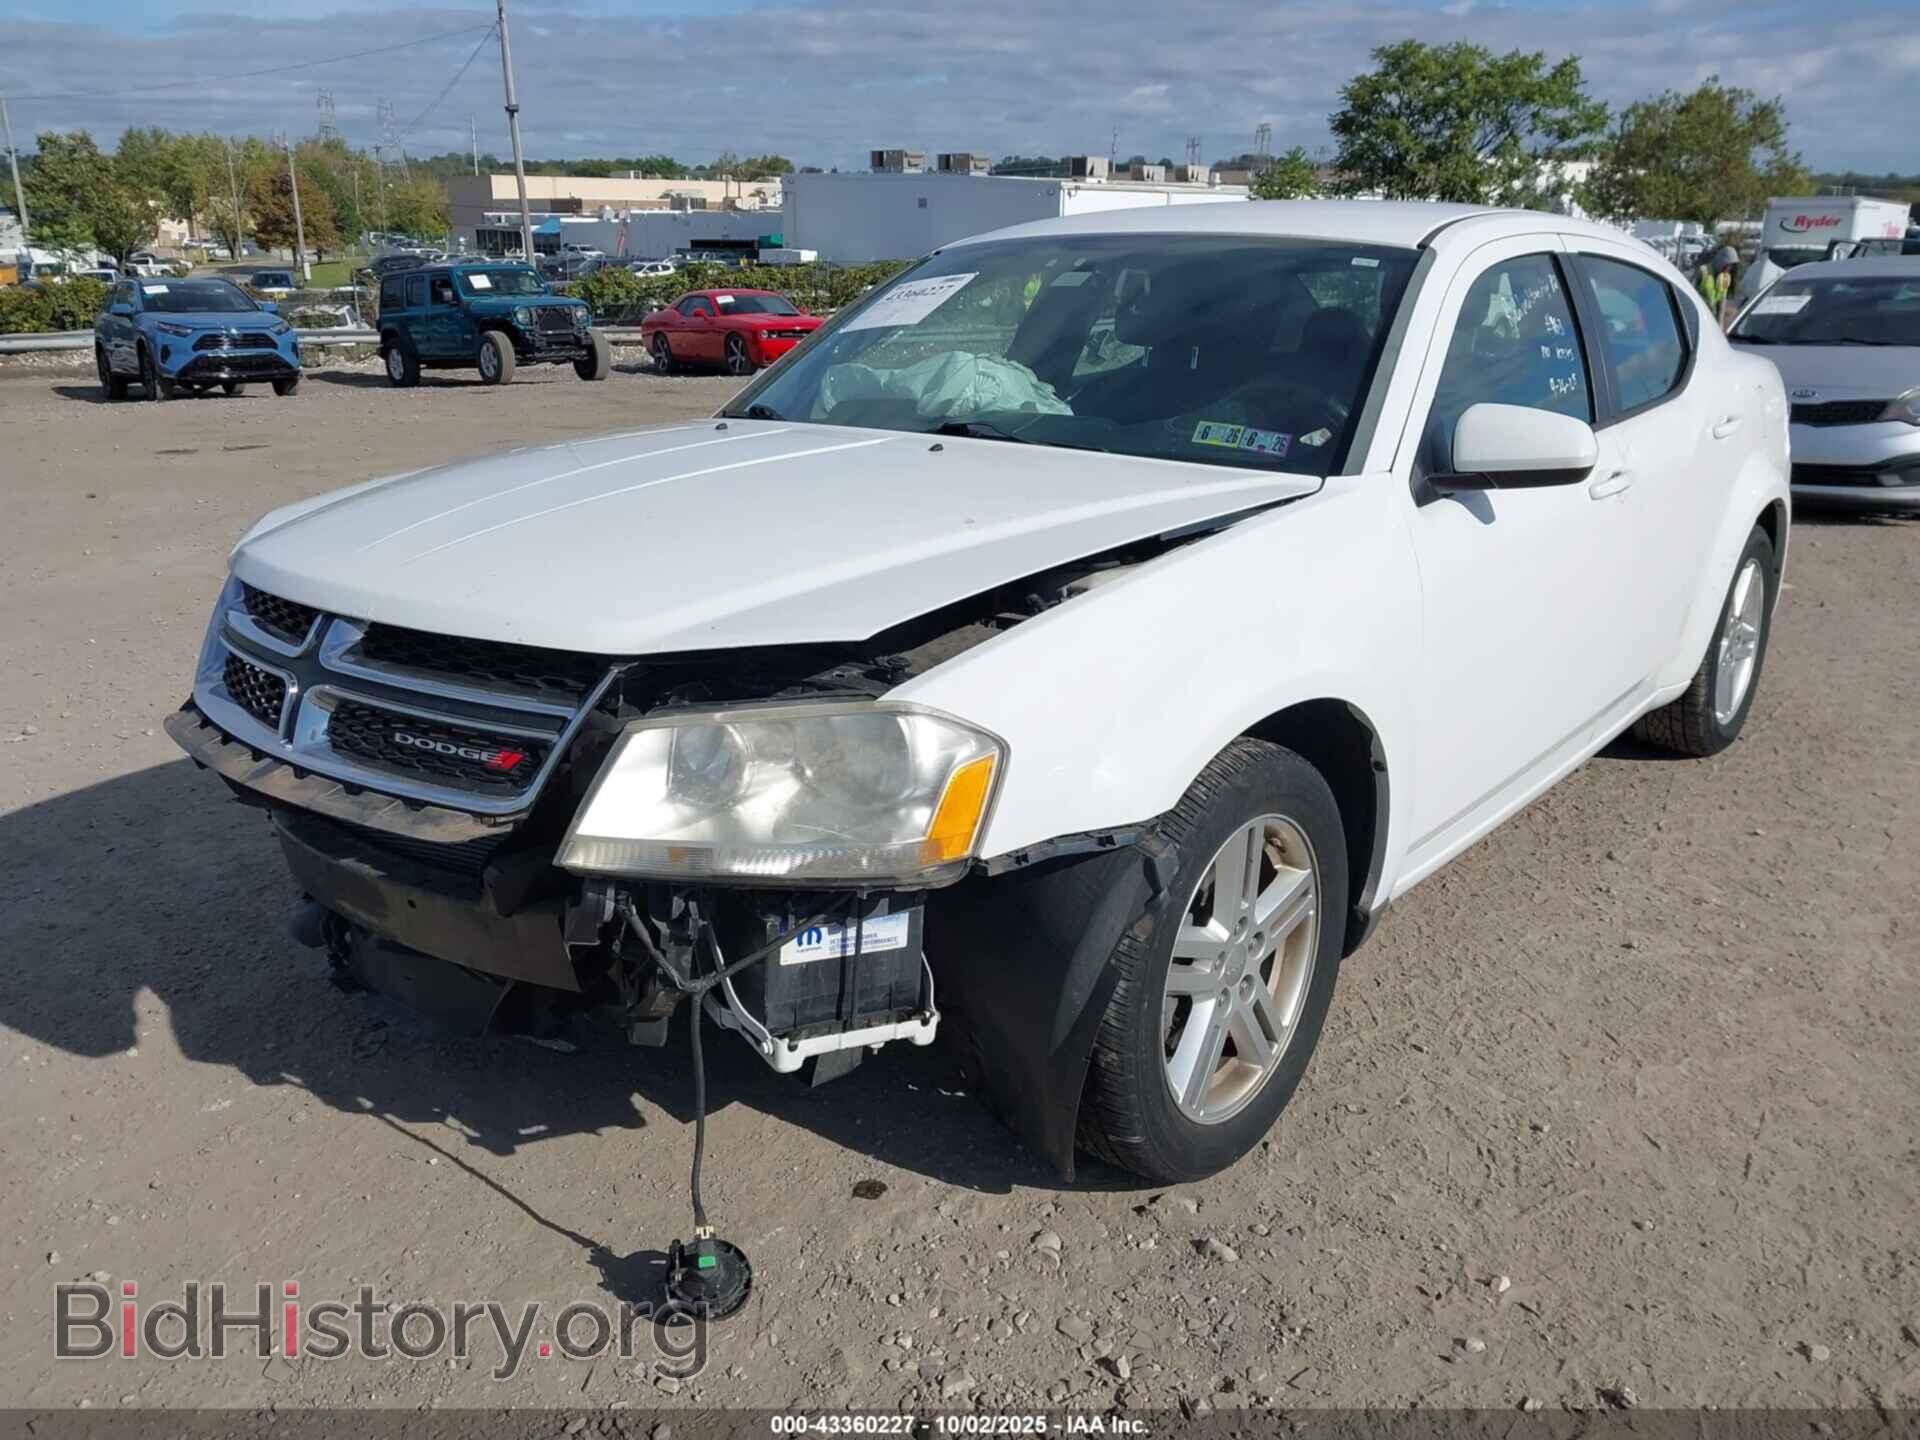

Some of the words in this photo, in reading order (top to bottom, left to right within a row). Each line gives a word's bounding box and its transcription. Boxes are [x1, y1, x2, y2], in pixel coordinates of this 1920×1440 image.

[1793, 213, 1842, 231] Ryder
[1200, 424, 1212, 440] 6
[1246, 431, 1258, 447] 6
[393, 732, 502, 764] DODGE
